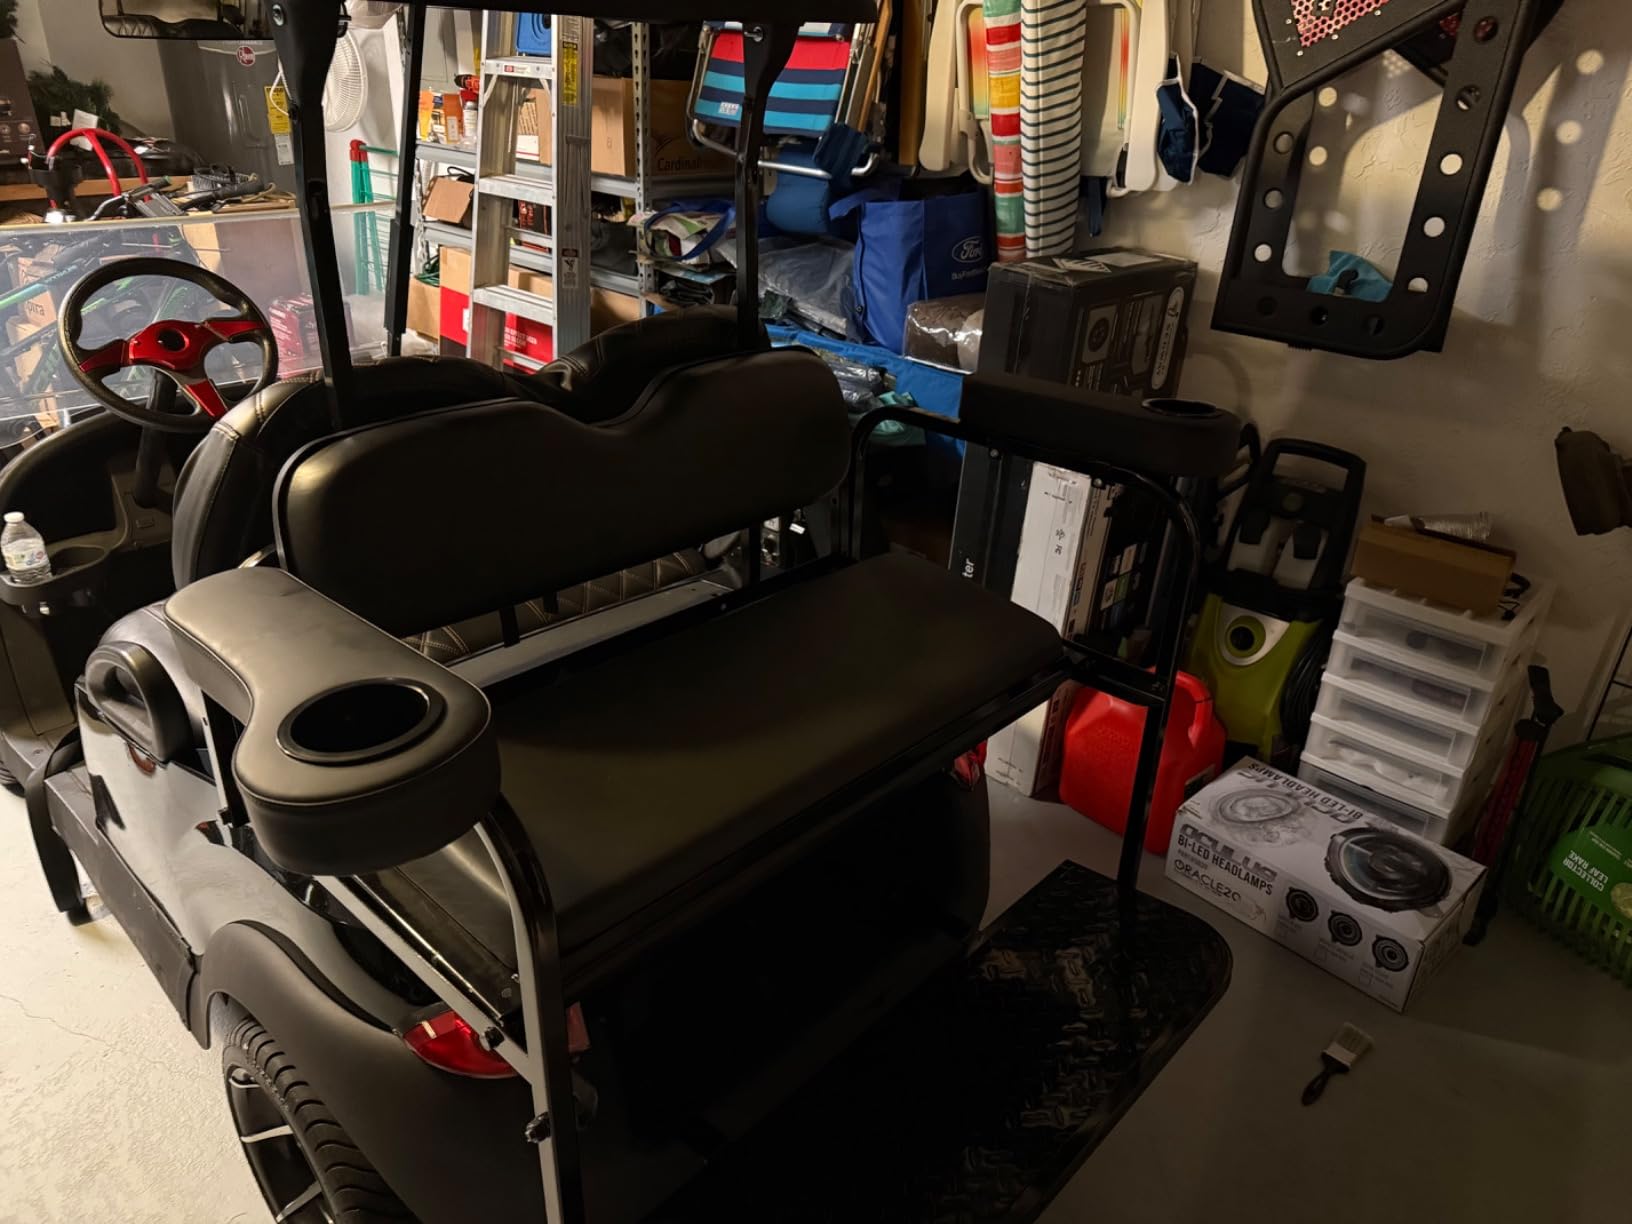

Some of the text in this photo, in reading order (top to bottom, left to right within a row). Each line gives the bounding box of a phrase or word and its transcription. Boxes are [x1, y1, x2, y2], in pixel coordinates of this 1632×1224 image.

[1249, 763, 1321, 799] HEADLAMPS
[1178, 834, 1210, 860] BI-LED
[1212, 854, 1273, 896] HEADLAMPS
[1562, 857, 1605, 892] COLLECTOR
[1567, 849, 1609, 885] LEAF RAKE
